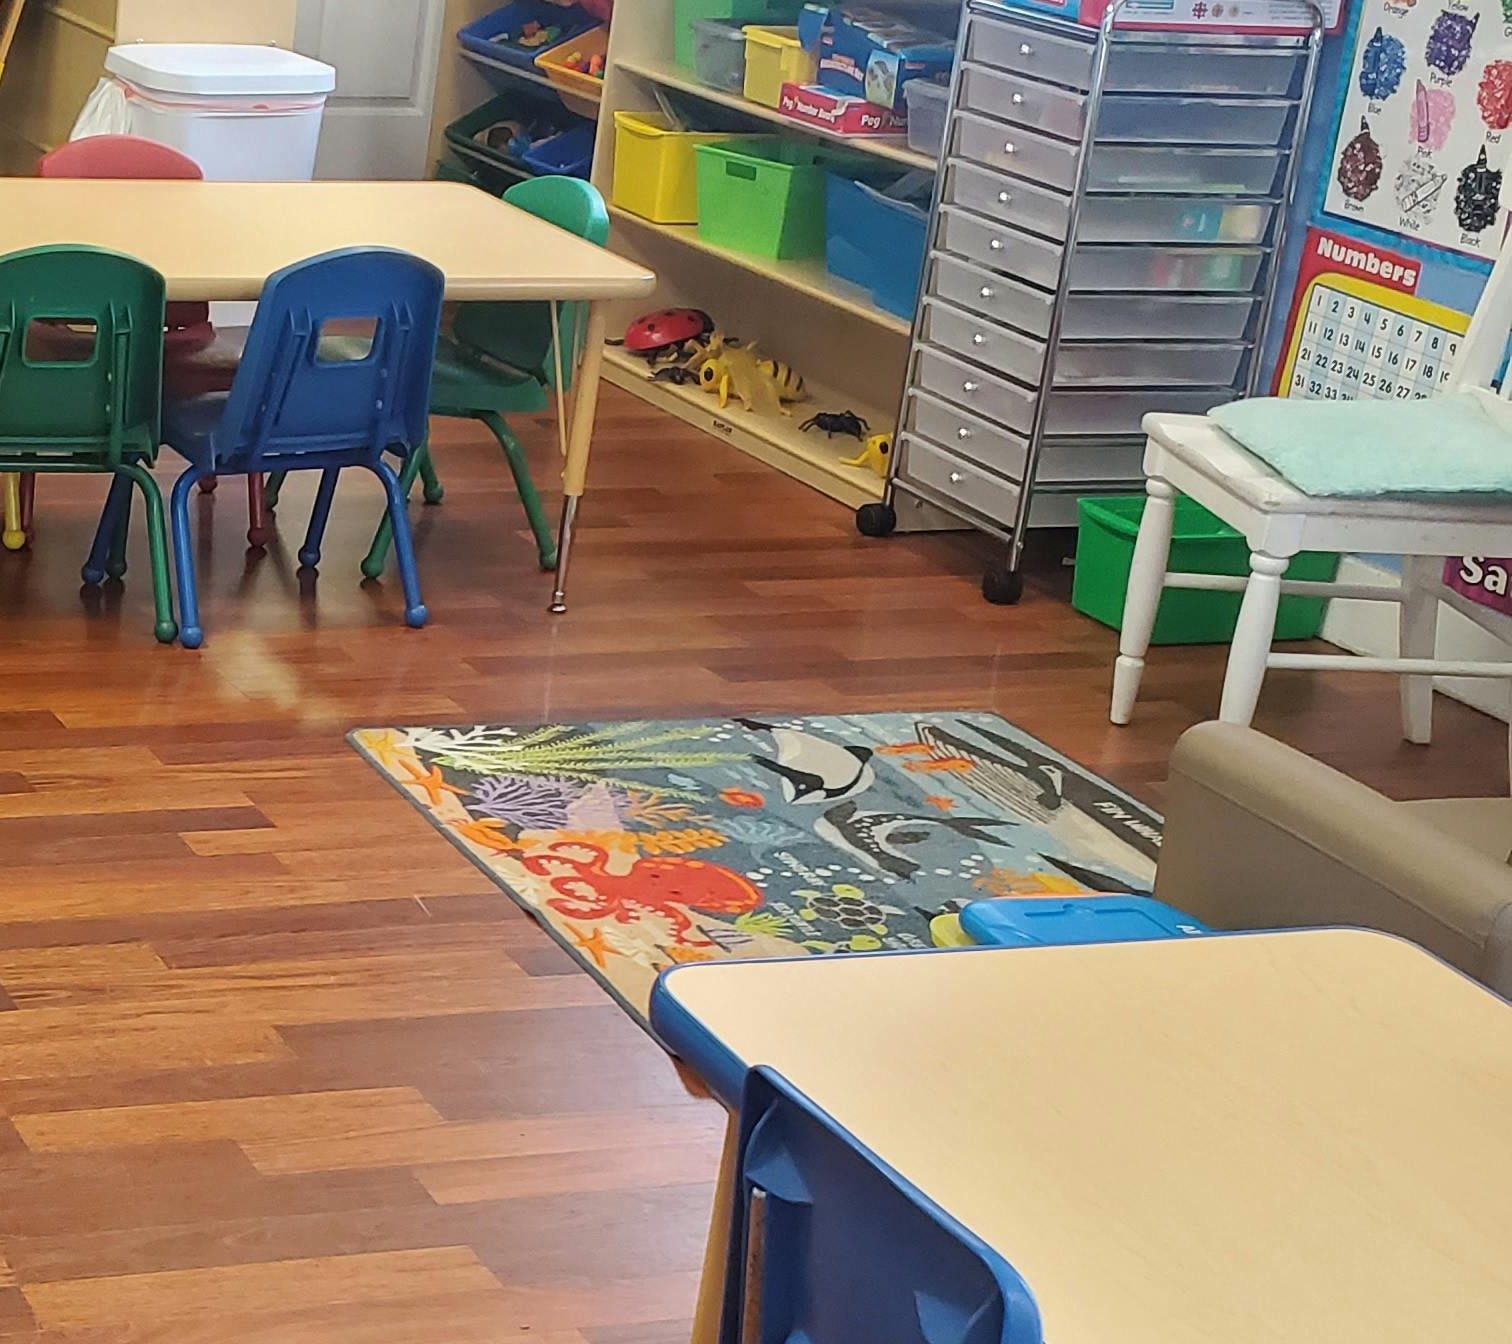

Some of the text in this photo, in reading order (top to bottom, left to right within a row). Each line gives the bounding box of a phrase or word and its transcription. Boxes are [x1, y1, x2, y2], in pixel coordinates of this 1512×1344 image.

[1383, 1, 1410, 19] Orange
[1367, 72, 1454, 116] Blue Purple
[861, 114, 881, 129] Peg
[1486, 131, 1502, 144] Red
[1417, 145, 1433, 159] Pink
[1344, 199, 1482, 249] Brown White Black
[1316, 236, 1417, 287] Numbers
[1317, 295, 1457, 356] 1 2 3 4 5 6 7 8 9
[1308, 321, 1318, 335] 11
[1323, 327, 1334, 342] 12
[1339, 332, 1350, 348] 13
[1354, 338, 1366, 353] 14
[1371, 344, 1383, 359] 15
[1388, 351, 1399, 366] 16
[1405, 357, 1417, 372] 17
[1422, 364, 1433, 379] 18
[1295, 374, 1305, 388] 31
[1309, 381, 1322, 396] 32
[1324, 387, 1337, 401] 33
[1300, 348, 1311, 362] 21
[1315, 354, 1328, 369] 22
[1330, 360, 1343, 375] 23
[1346, 366, 1360, 381] 24
[1362, 372, 1377, 388] 25
[1378, 379, 1392, 394] 26
[1396, 385, 1411, 400] 27
